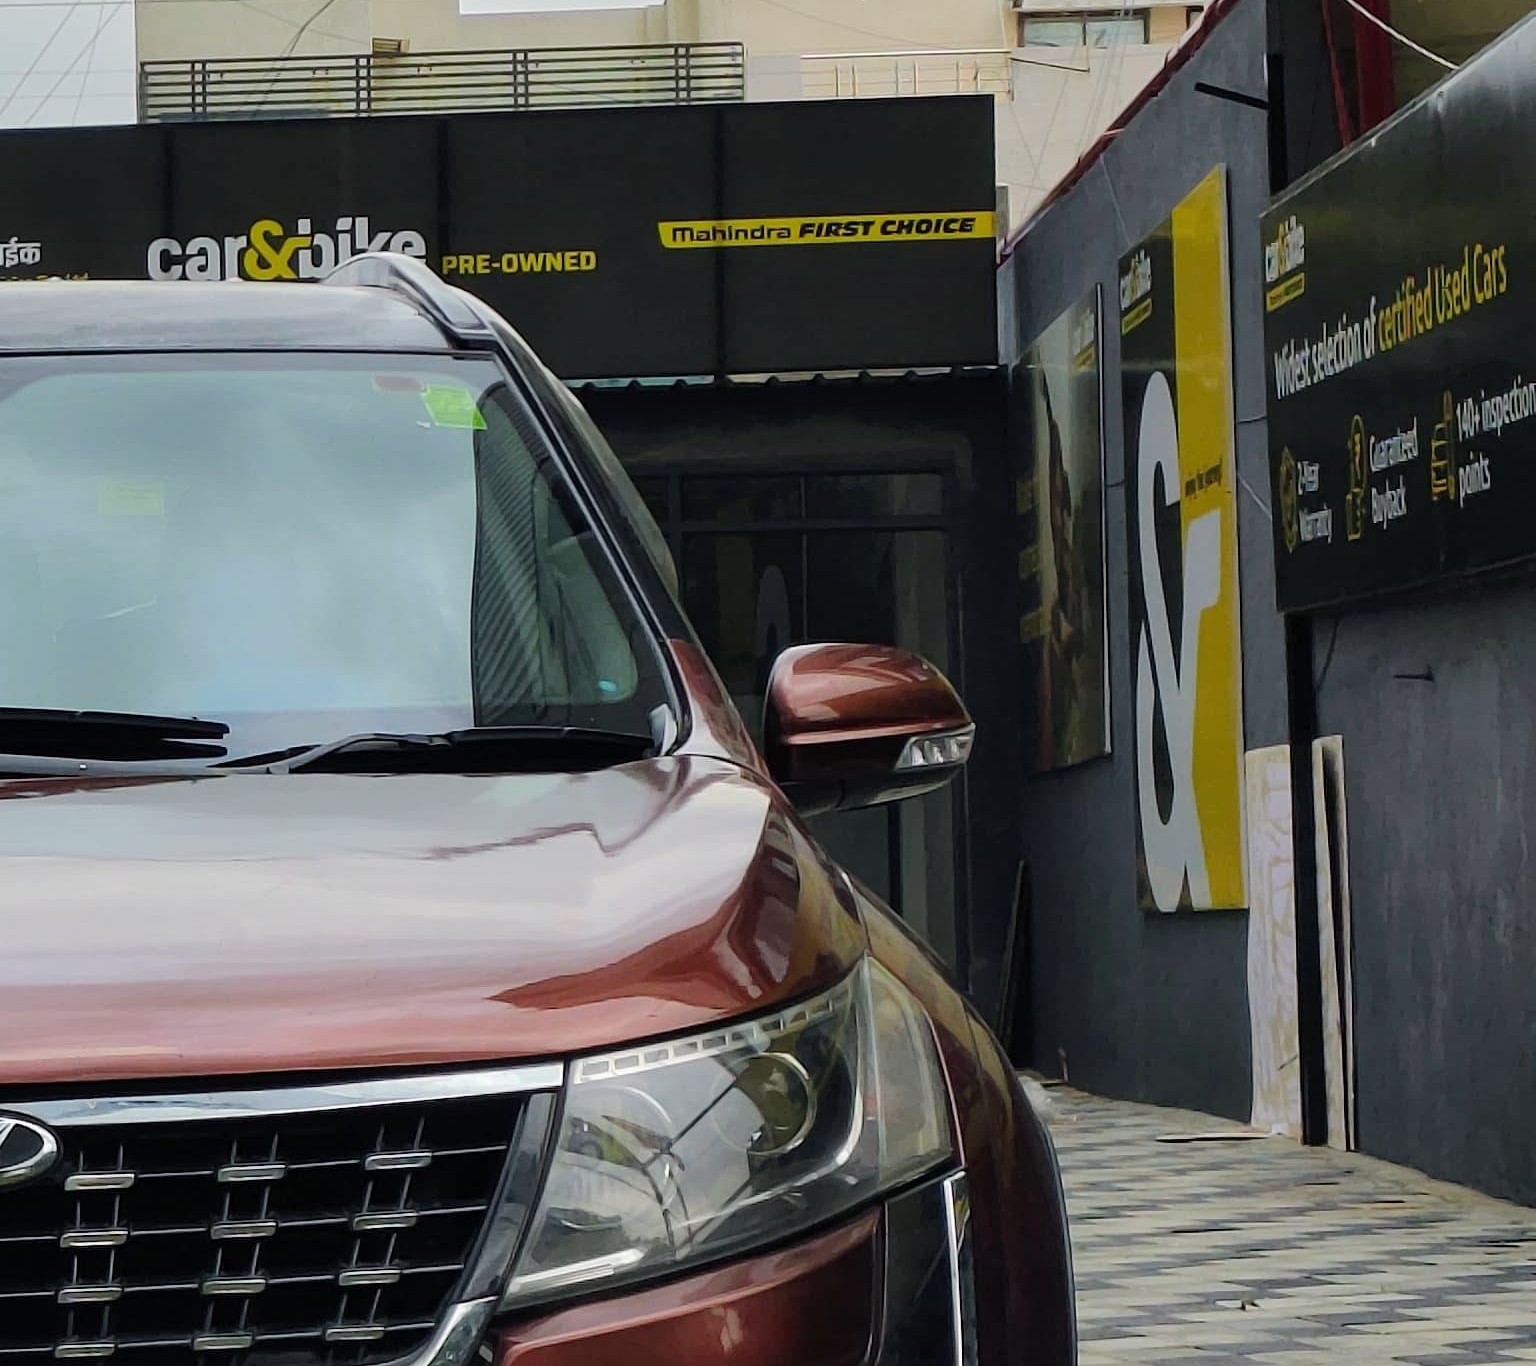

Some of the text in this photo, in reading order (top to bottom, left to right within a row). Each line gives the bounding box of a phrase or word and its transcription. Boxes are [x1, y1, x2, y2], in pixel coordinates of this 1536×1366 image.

[672, 217, 977, 243] Mahindra FIRST CHOICE
[442, 250, 598, 276] PRE-OWNED
[1273, 338, 1313, 401] Widest
[1312, 312, 1363, 385] selection
[1363, 294, 1376, 360] of
[1377, 266, 1433, 352] certified
[1433, 244, 1471, 325] Used
[1472, 243, 1508, 305] Cars
[1455, 374, 1536, 443] 140+ inspection
[1458, 450, 1491, 508] points
